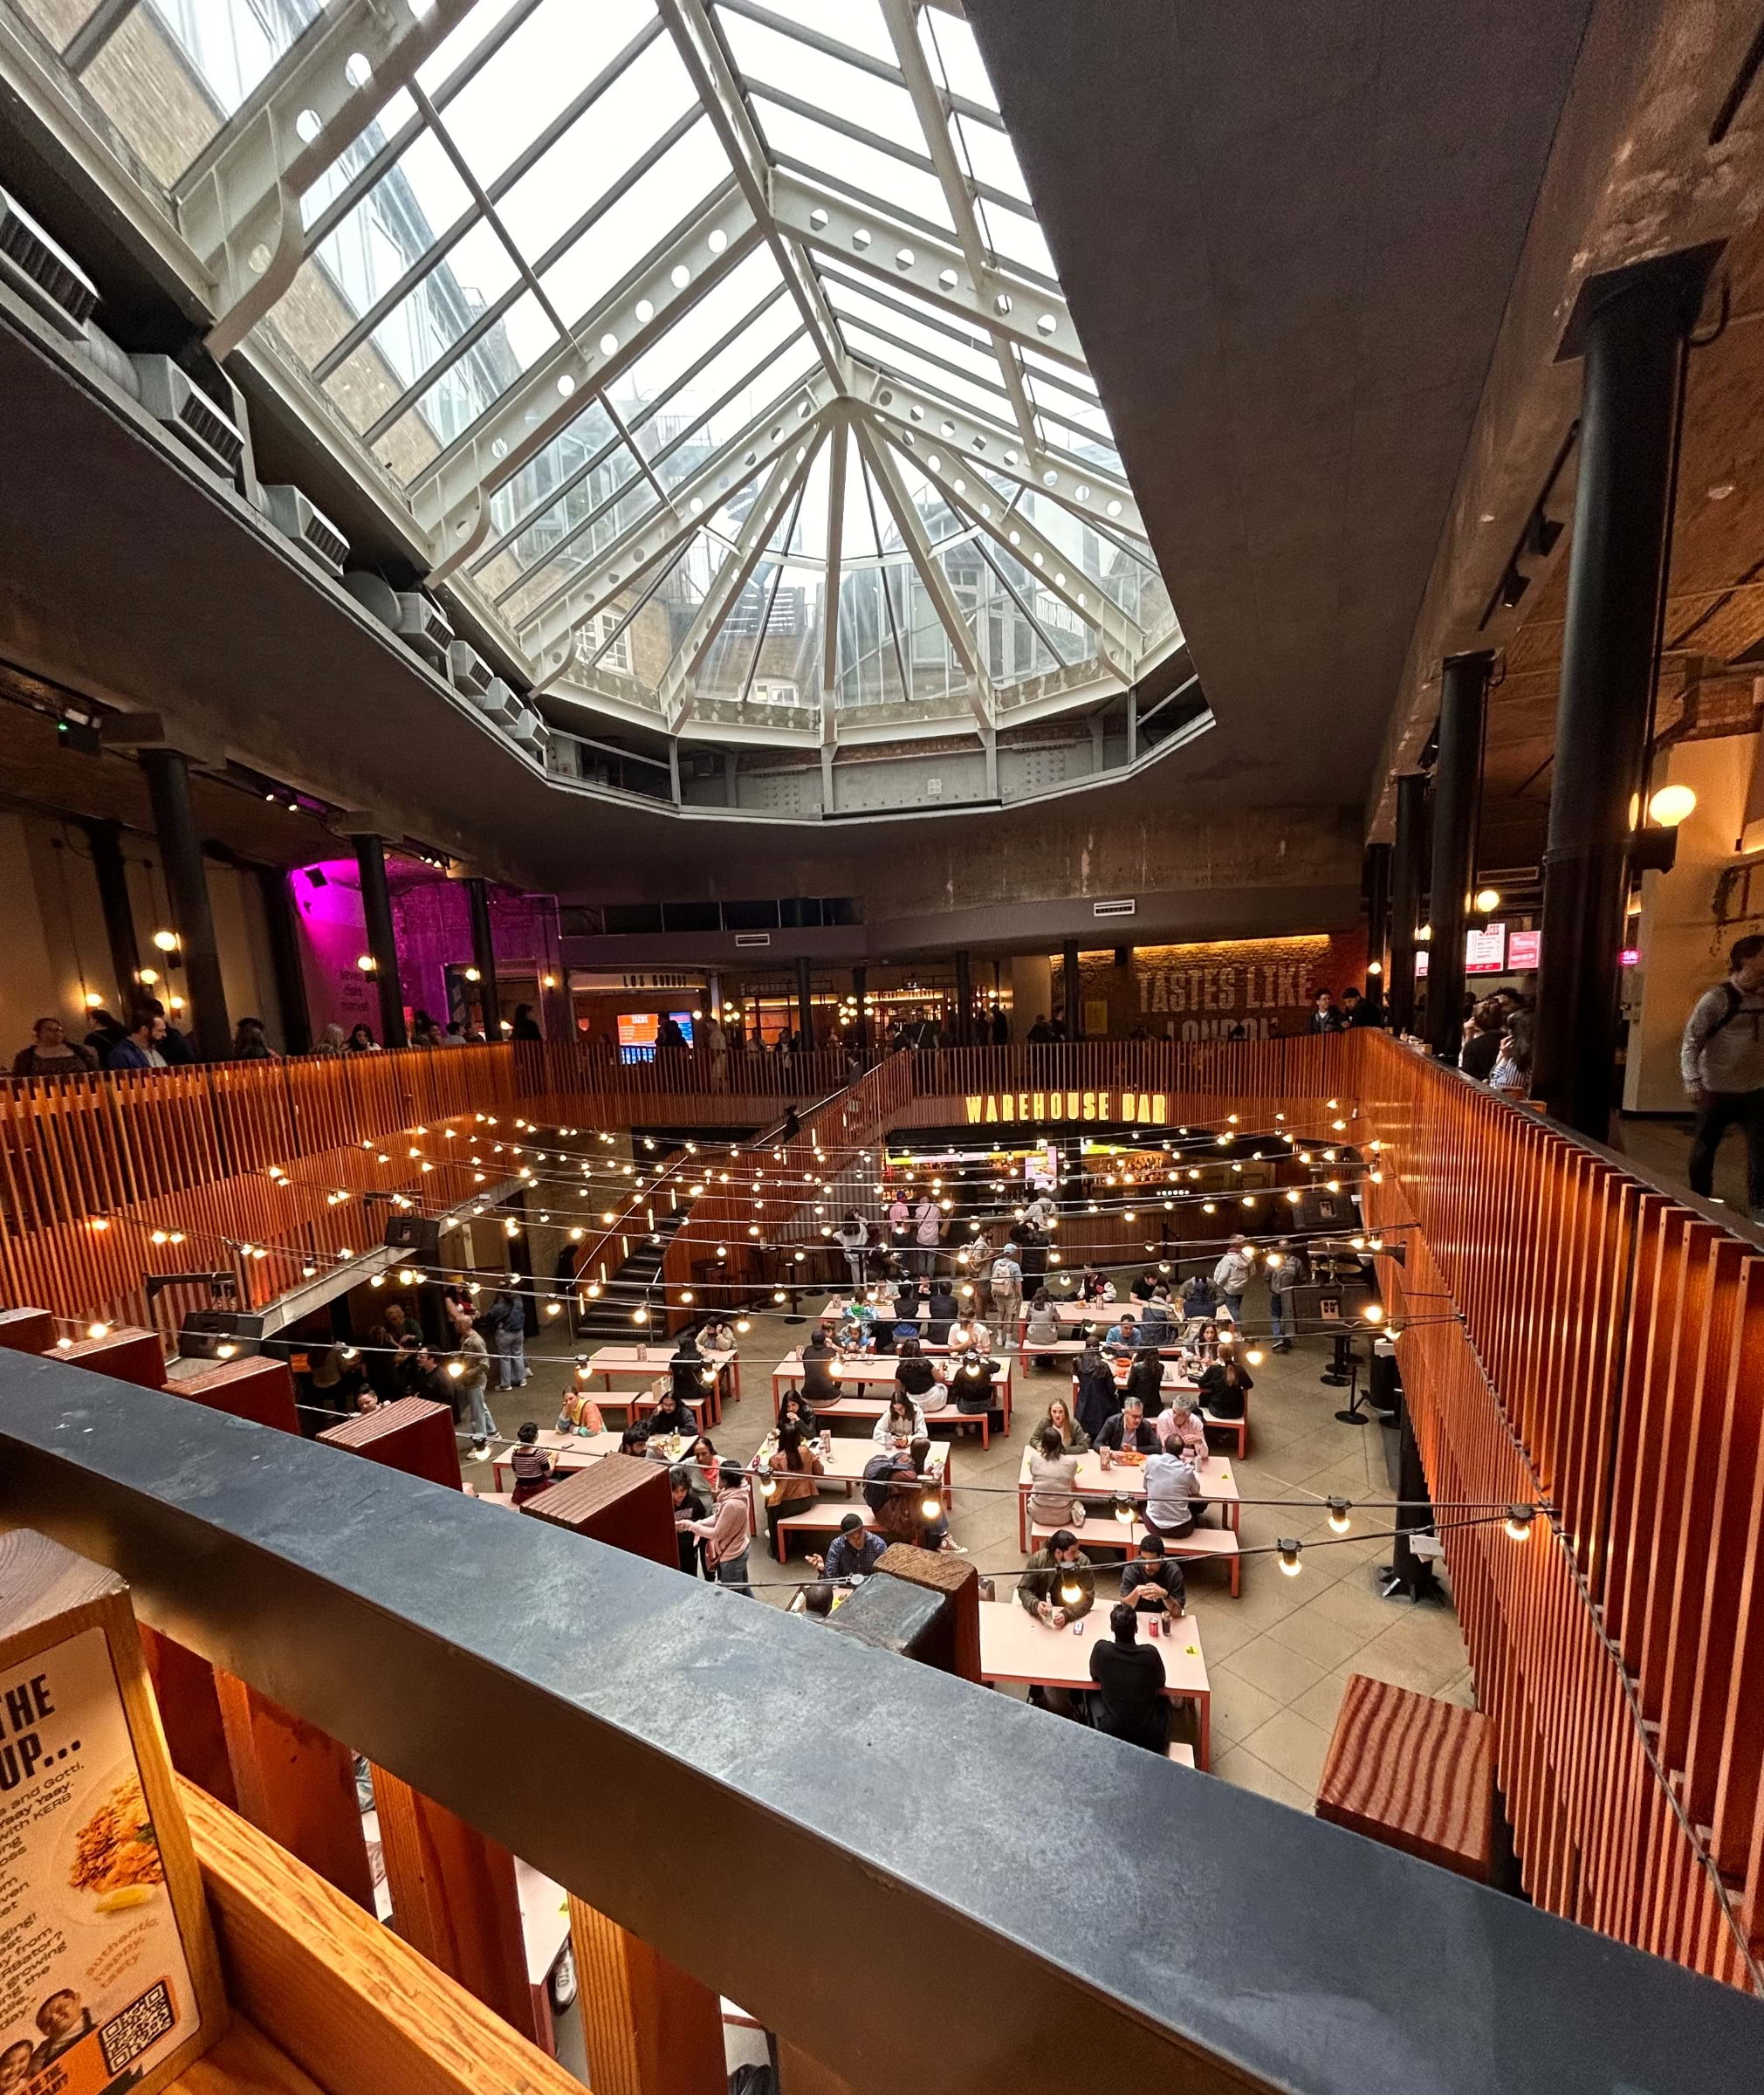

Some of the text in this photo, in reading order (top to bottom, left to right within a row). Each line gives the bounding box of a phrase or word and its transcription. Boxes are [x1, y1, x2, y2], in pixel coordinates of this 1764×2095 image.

[1136, 963, 1312, 1013] TASTES LIKE
[965, 1092, 1166, 1124] WAREHOUSE BAR
[11, 1786, 40, 1810] and
[33, 1792, 72, 1821] KERB
[15, 1927, 52, 1956] from
[6, 1940, 67, 1989] growing
[24, 1966, 51, 1986] the
